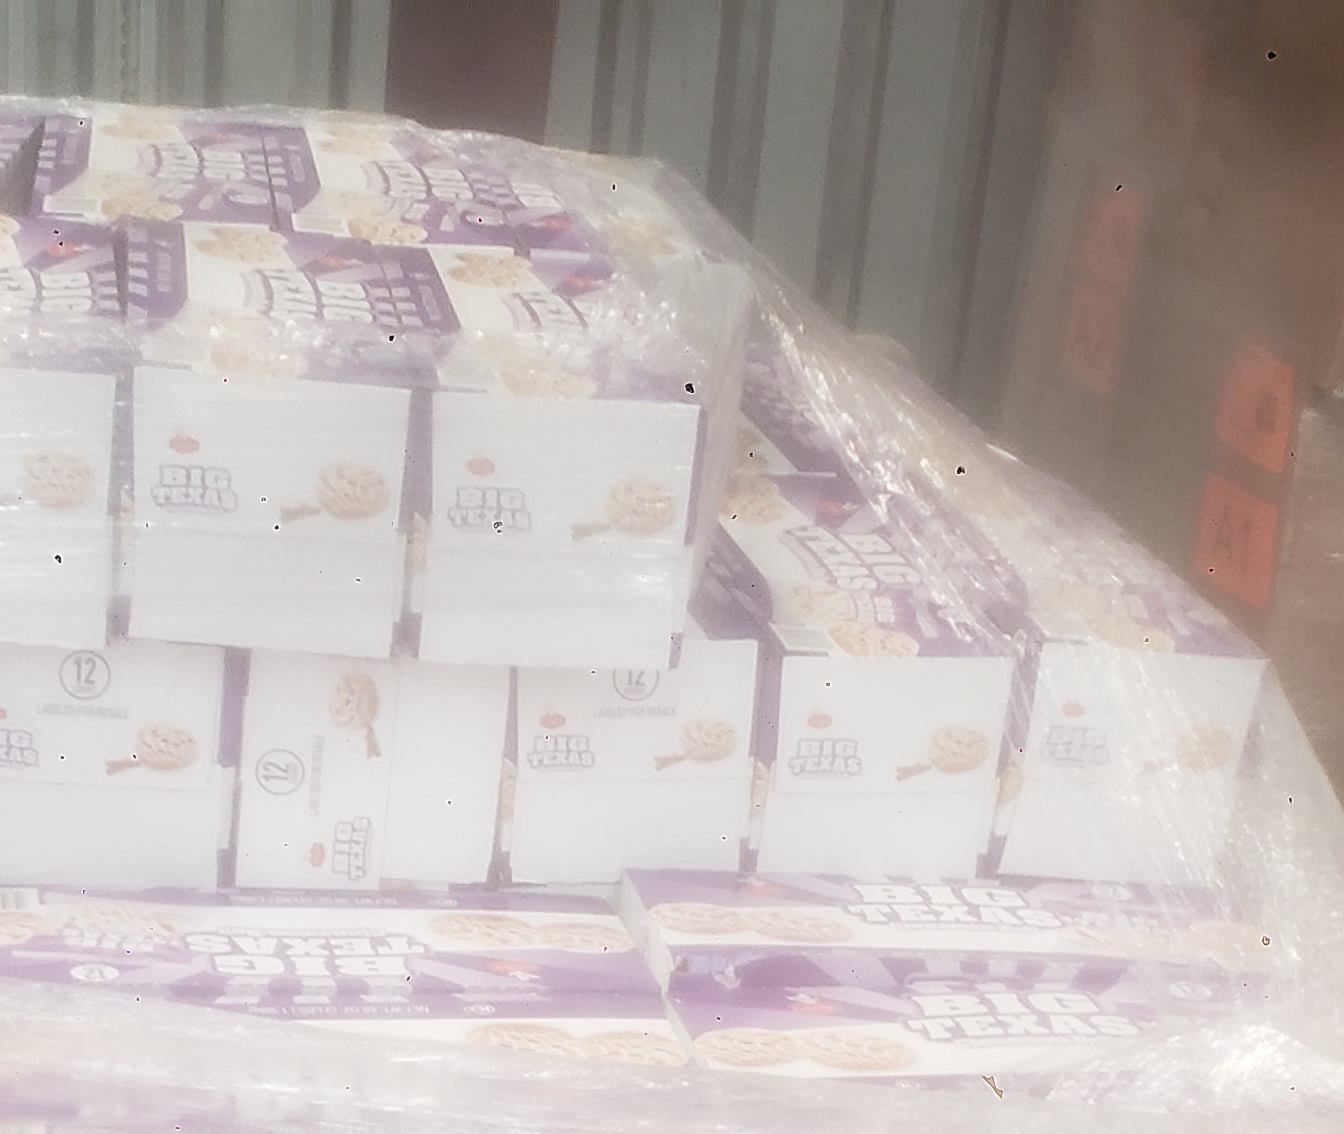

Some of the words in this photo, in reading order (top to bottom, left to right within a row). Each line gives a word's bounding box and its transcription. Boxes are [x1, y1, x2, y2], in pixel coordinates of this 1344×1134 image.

[319, 281, 372, 323] BIG
[159, 465, 231, 489] BIG
[150, 485, 239, 511] TEXAS
[457, 487, 525, 511] BIG
[846, 533, 920, 584] BIG
[73, 656, 98, 686] 12
[534, 734, 590, 753] BIG
[796, 739, 859, 758] BIG
[261, 757, 292, 785] 12
[527, 749, 597, 771] TEXAS
[789, 755, 862, 778] TEXAS
[333, 820, 354, 876] BIG
[347, 816, 373, 880] TEXAS
[853, 884, 1026, 907] BIG
[842, 904, 1062, 930] TEXAS
[184, 932, 431, 956] TEXAS
[208, 954, 412, 976] BIG
[910, 991, 1103, 1018] BIG
[903, 1013, 1143, 1040] TEXAS
